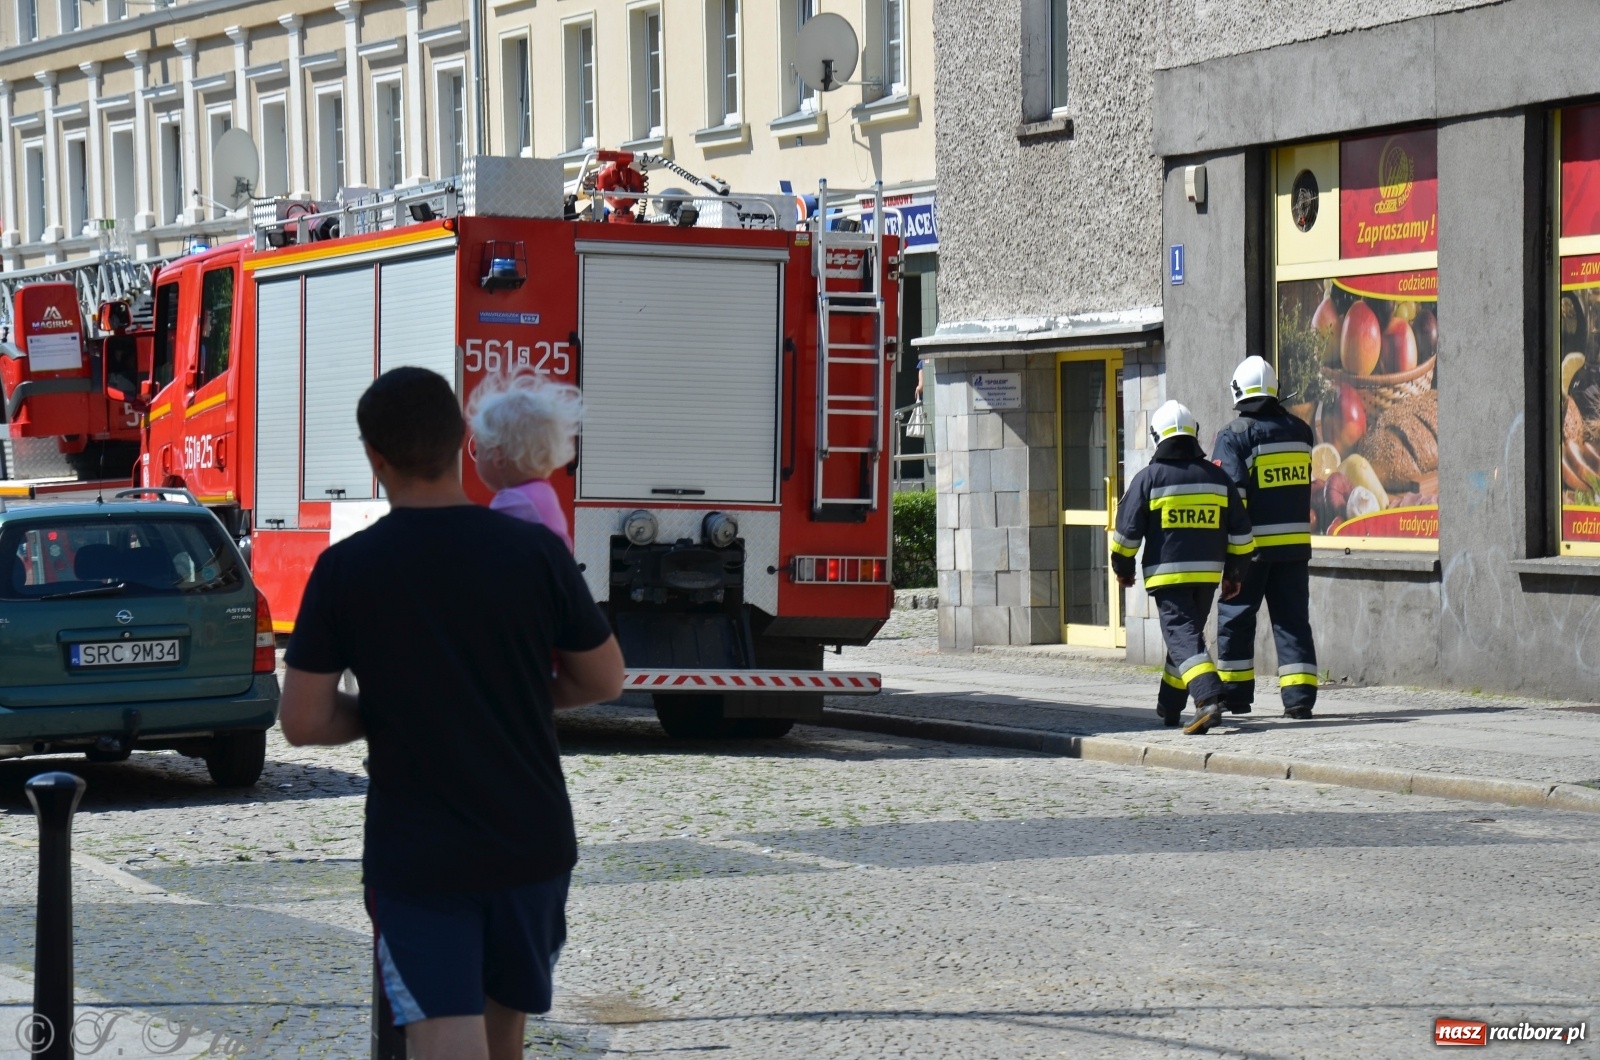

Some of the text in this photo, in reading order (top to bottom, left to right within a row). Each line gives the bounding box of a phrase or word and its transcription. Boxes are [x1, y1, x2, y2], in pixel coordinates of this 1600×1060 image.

[1357, 214, 1435, 248] Zapraszamy !
[1174, 249, 1180, 271] 1
[31, 319, 73, 329] MAGIRUS
[83, 641, 177, 664] SRC 9M34
